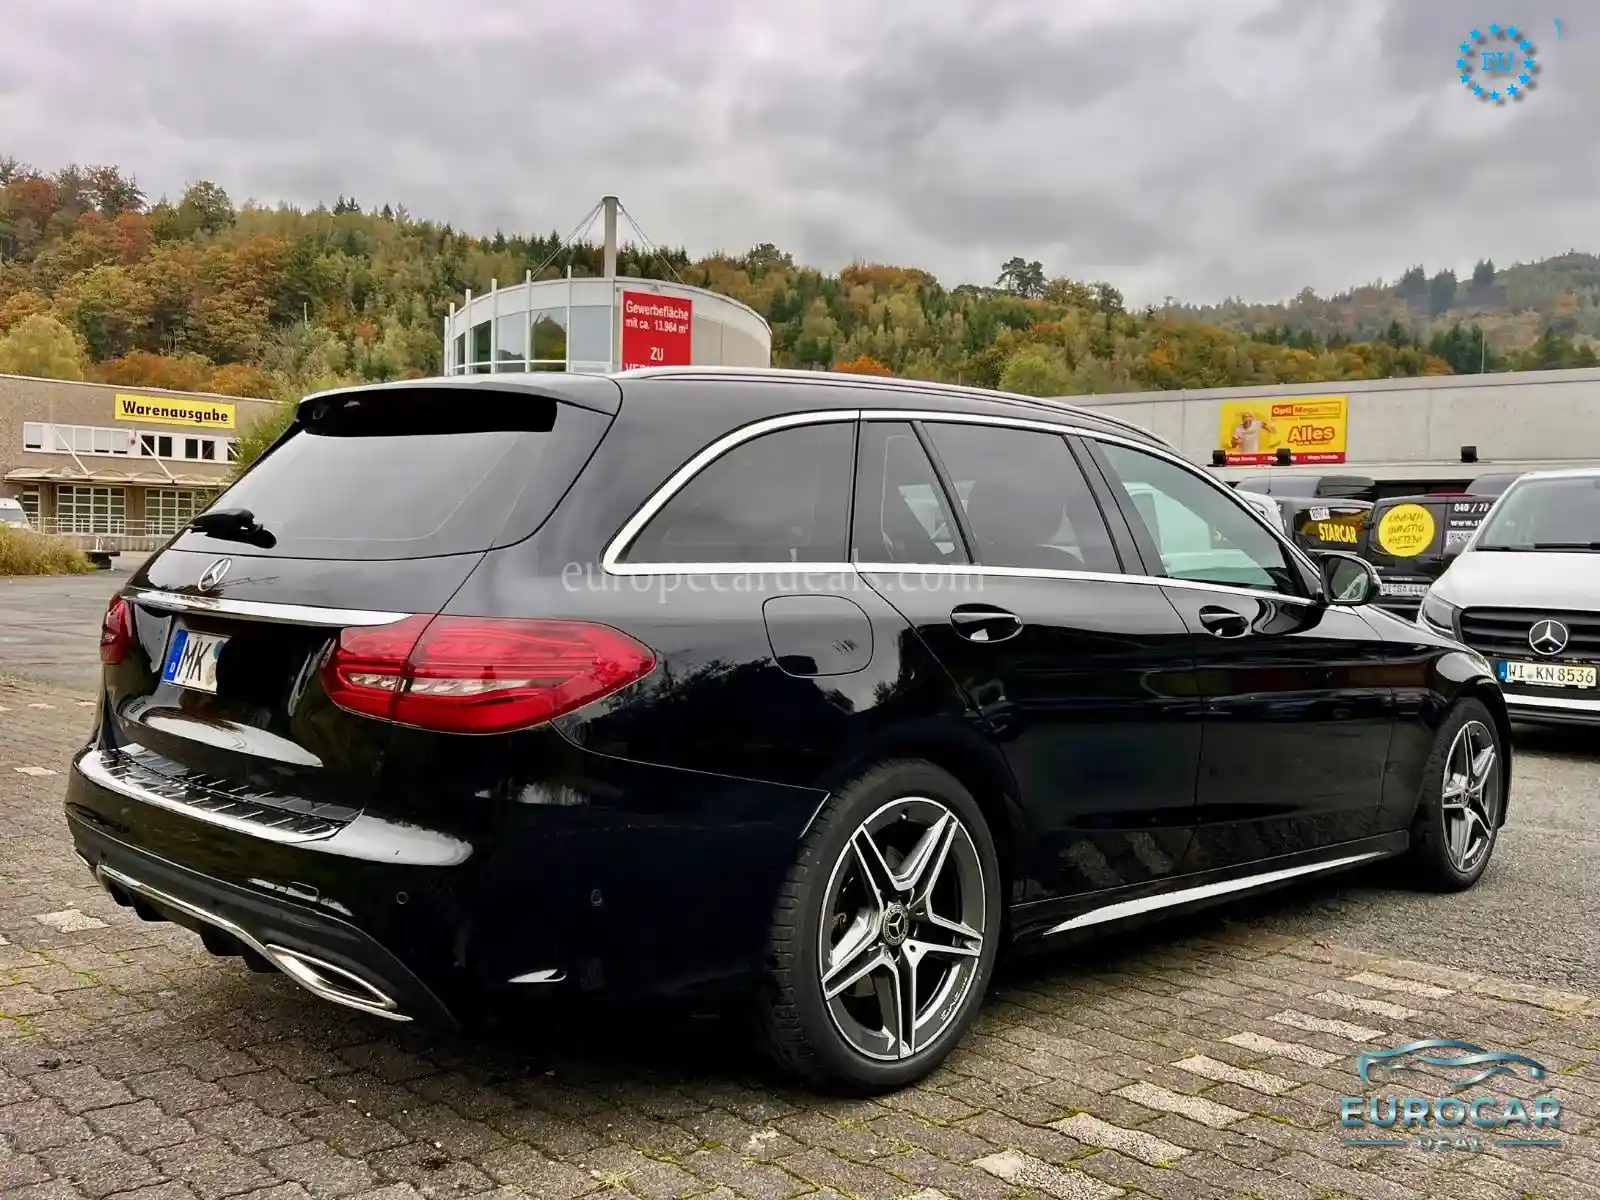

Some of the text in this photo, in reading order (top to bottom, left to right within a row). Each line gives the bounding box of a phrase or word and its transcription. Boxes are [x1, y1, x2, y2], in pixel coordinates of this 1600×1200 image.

[626, 300, 688, 320] Gewerbefläche
[625, 317, 638, 328] mit
[639, 320, 650, 330] ca.
[650, 346, 664, 361] ZU
[122, 400, 228, 422] Warenausgabe
[1288, 426, 1334, 442] Alles
[1454, 503, 1469, 512] 040
[1318, 522, 1358, 544] STARCAR
[177, 640, 212, 681] MK
[1508, 664, 1594, 683] WI KN 8536
